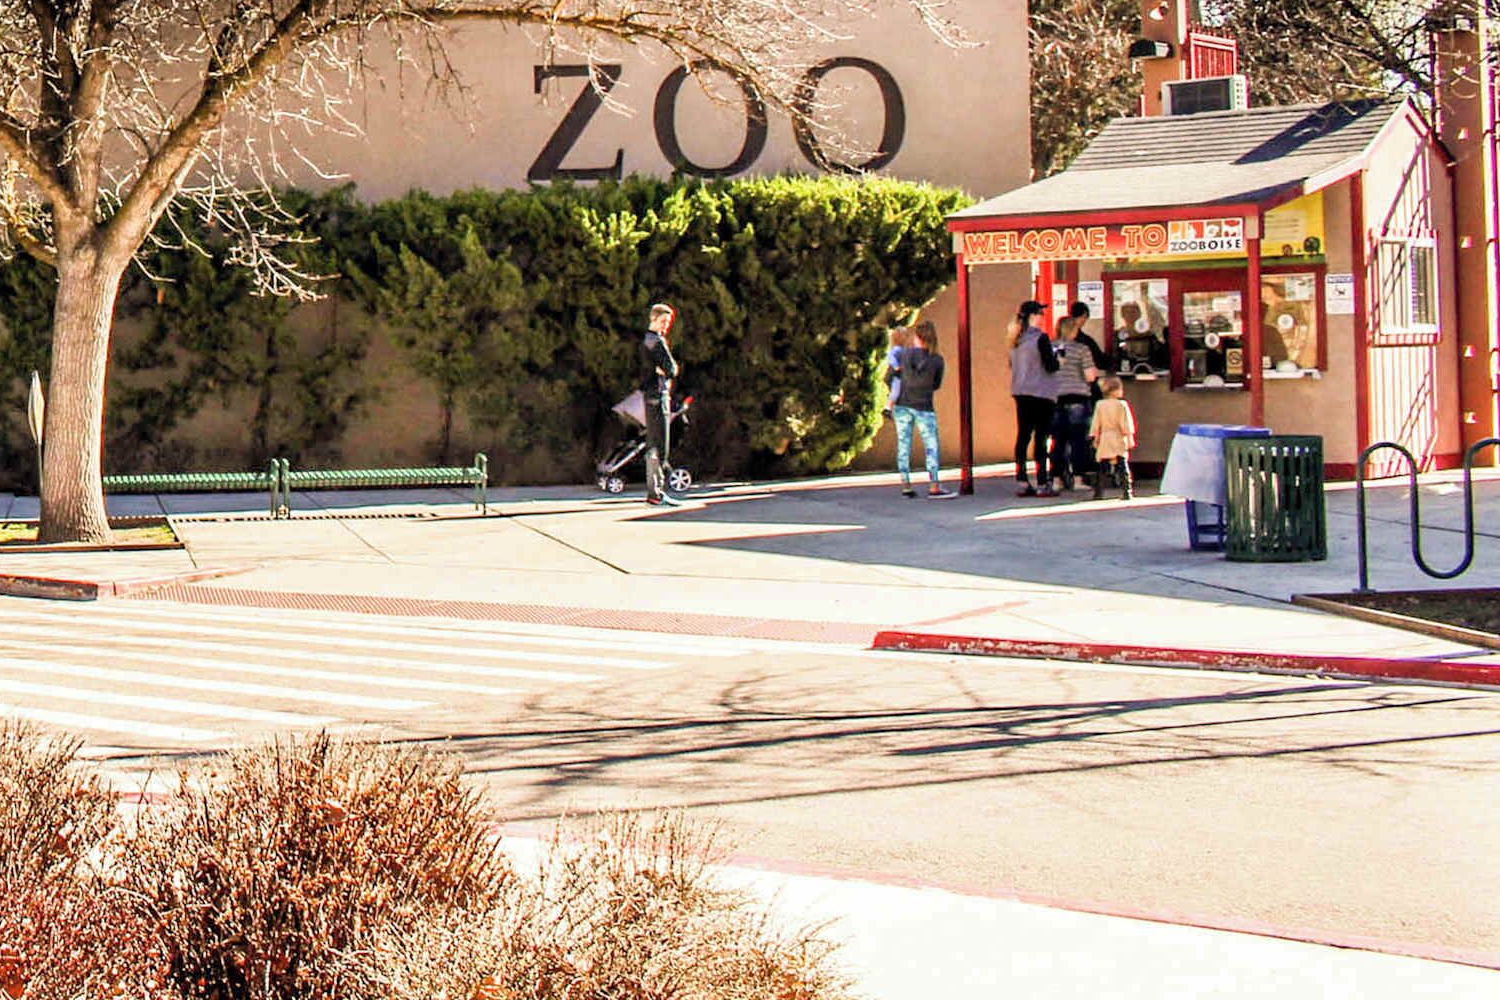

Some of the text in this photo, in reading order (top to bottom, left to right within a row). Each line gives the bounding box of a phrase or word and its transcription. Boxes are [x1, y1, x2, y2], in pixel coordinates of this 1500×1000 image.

[527, 56, 905, 181] ZOO
[965, 224, 1167, 256] WELCOME TO
